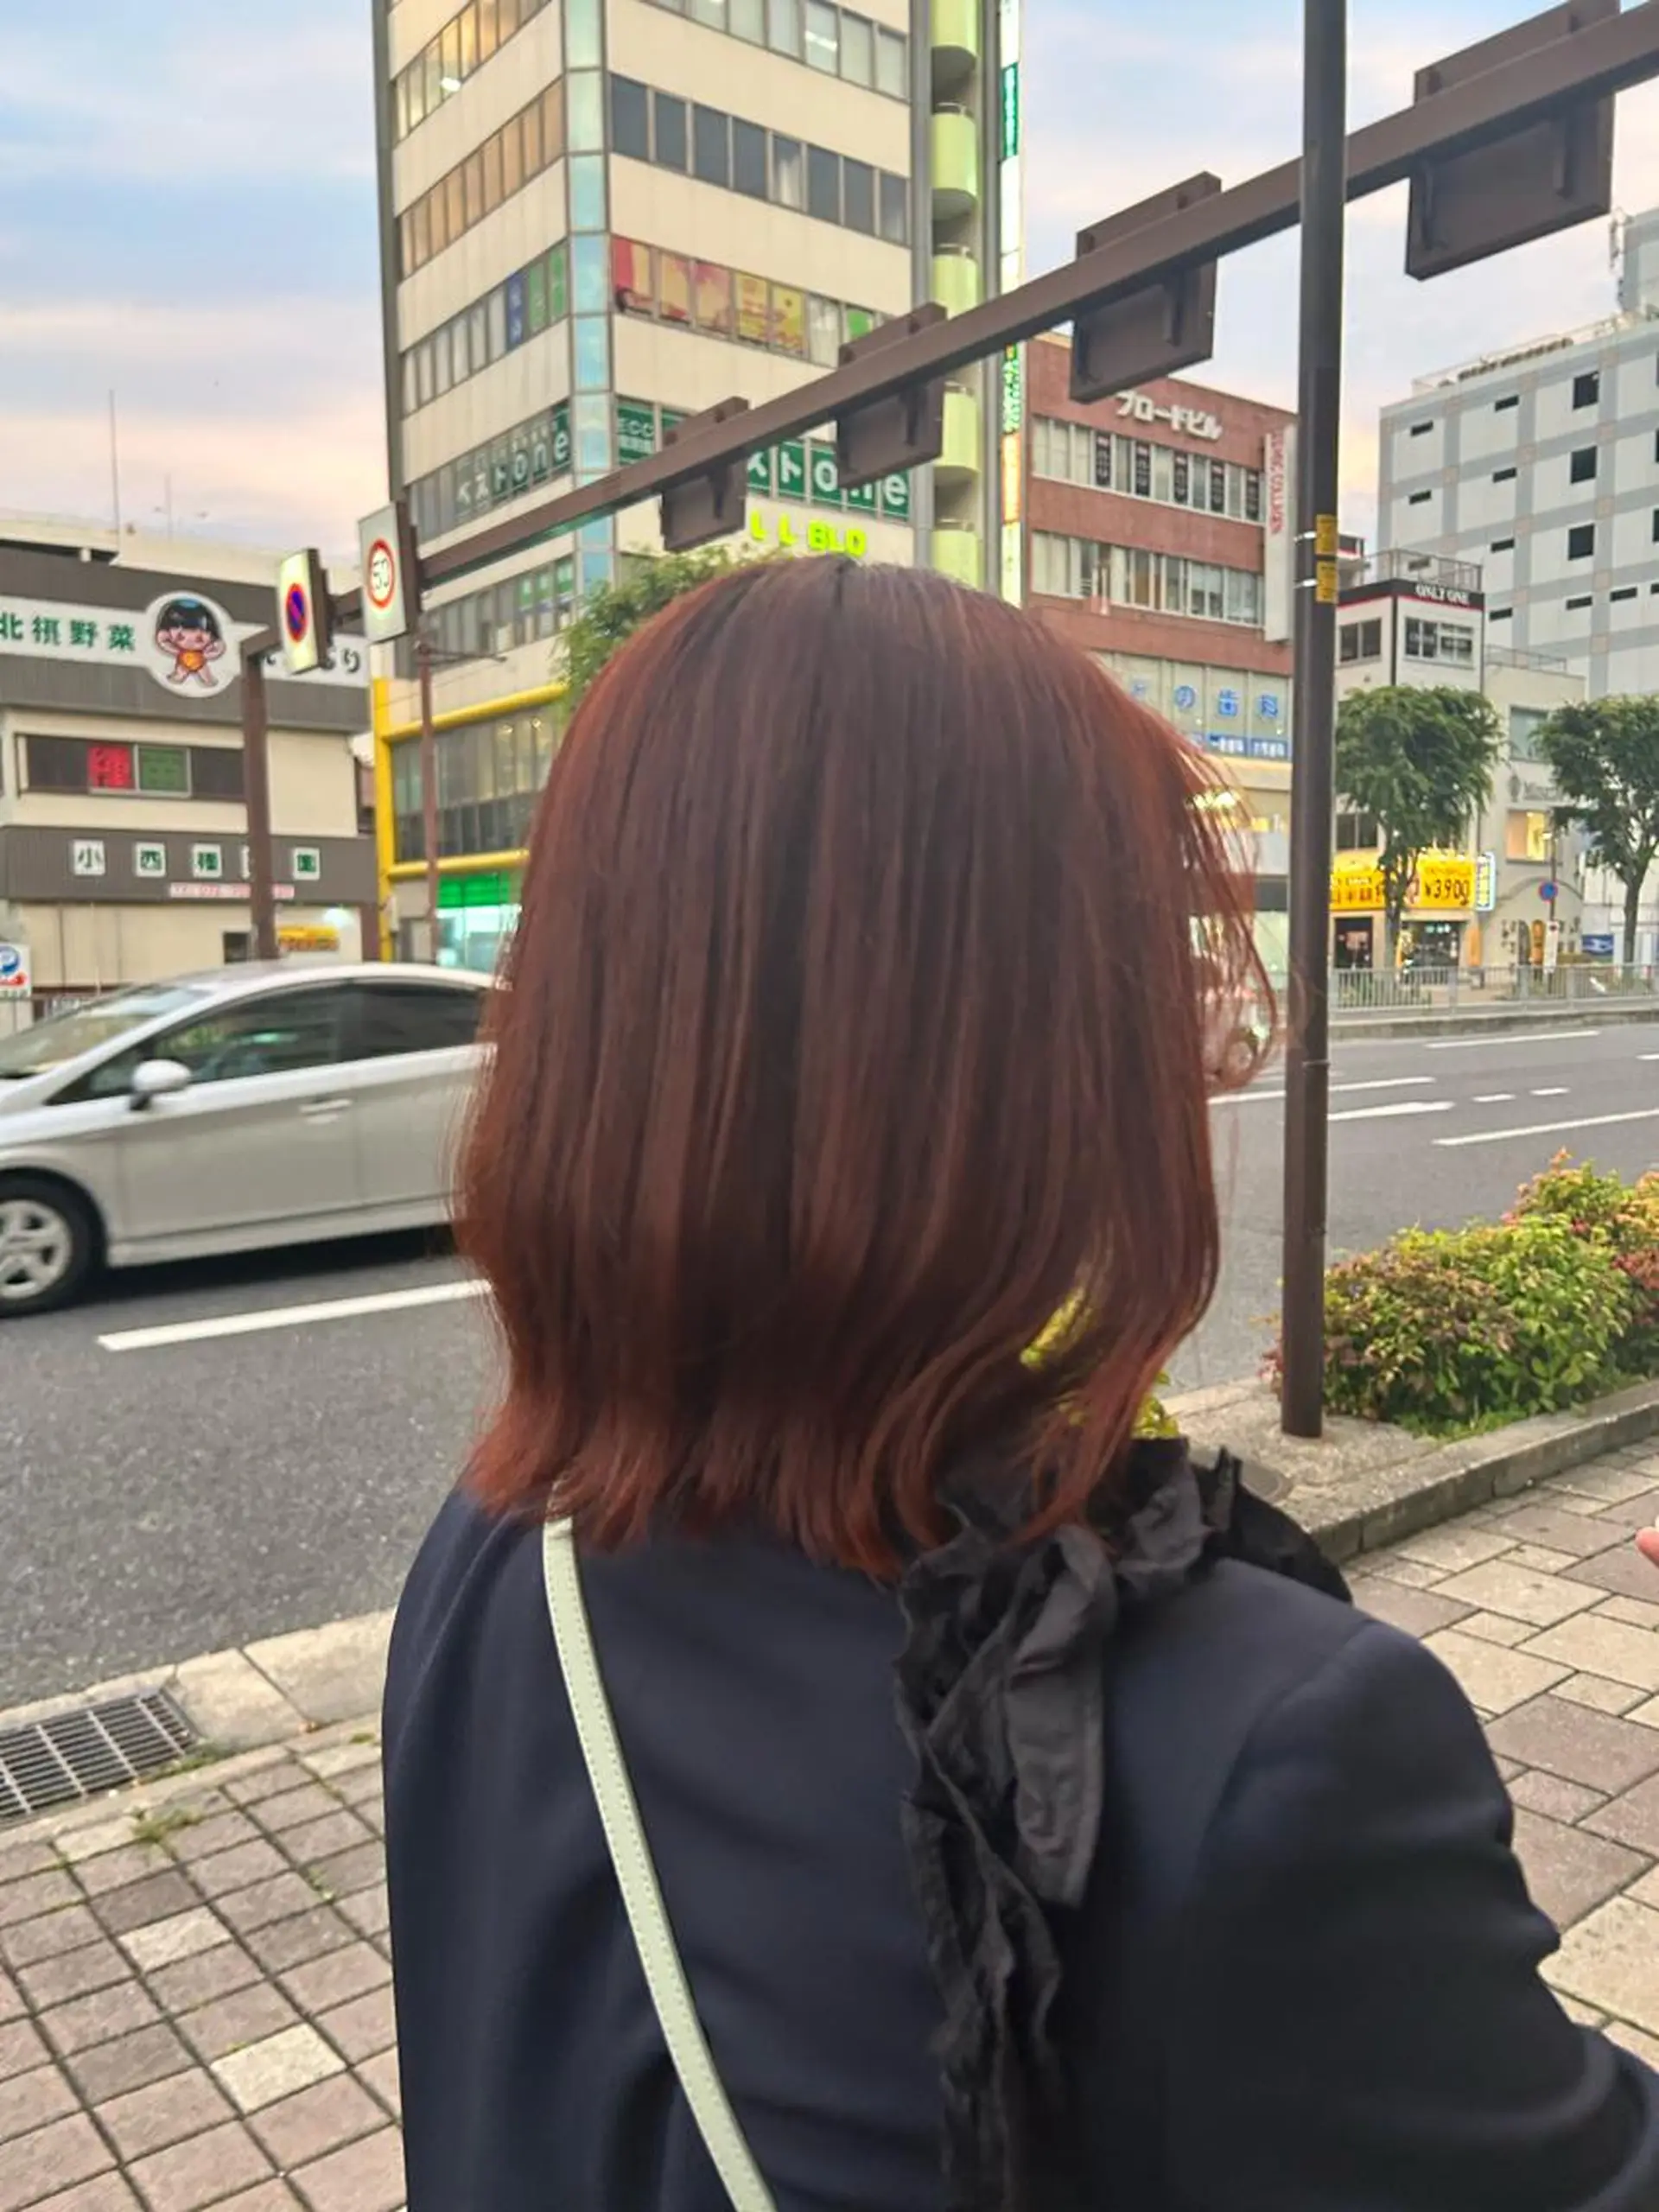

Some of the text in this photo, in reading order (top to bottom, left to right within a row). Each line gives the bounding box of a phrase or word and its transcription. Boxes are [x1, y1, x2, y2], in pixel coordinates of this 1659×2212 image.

[1116, 390, 1224, 441] ブロードビル
